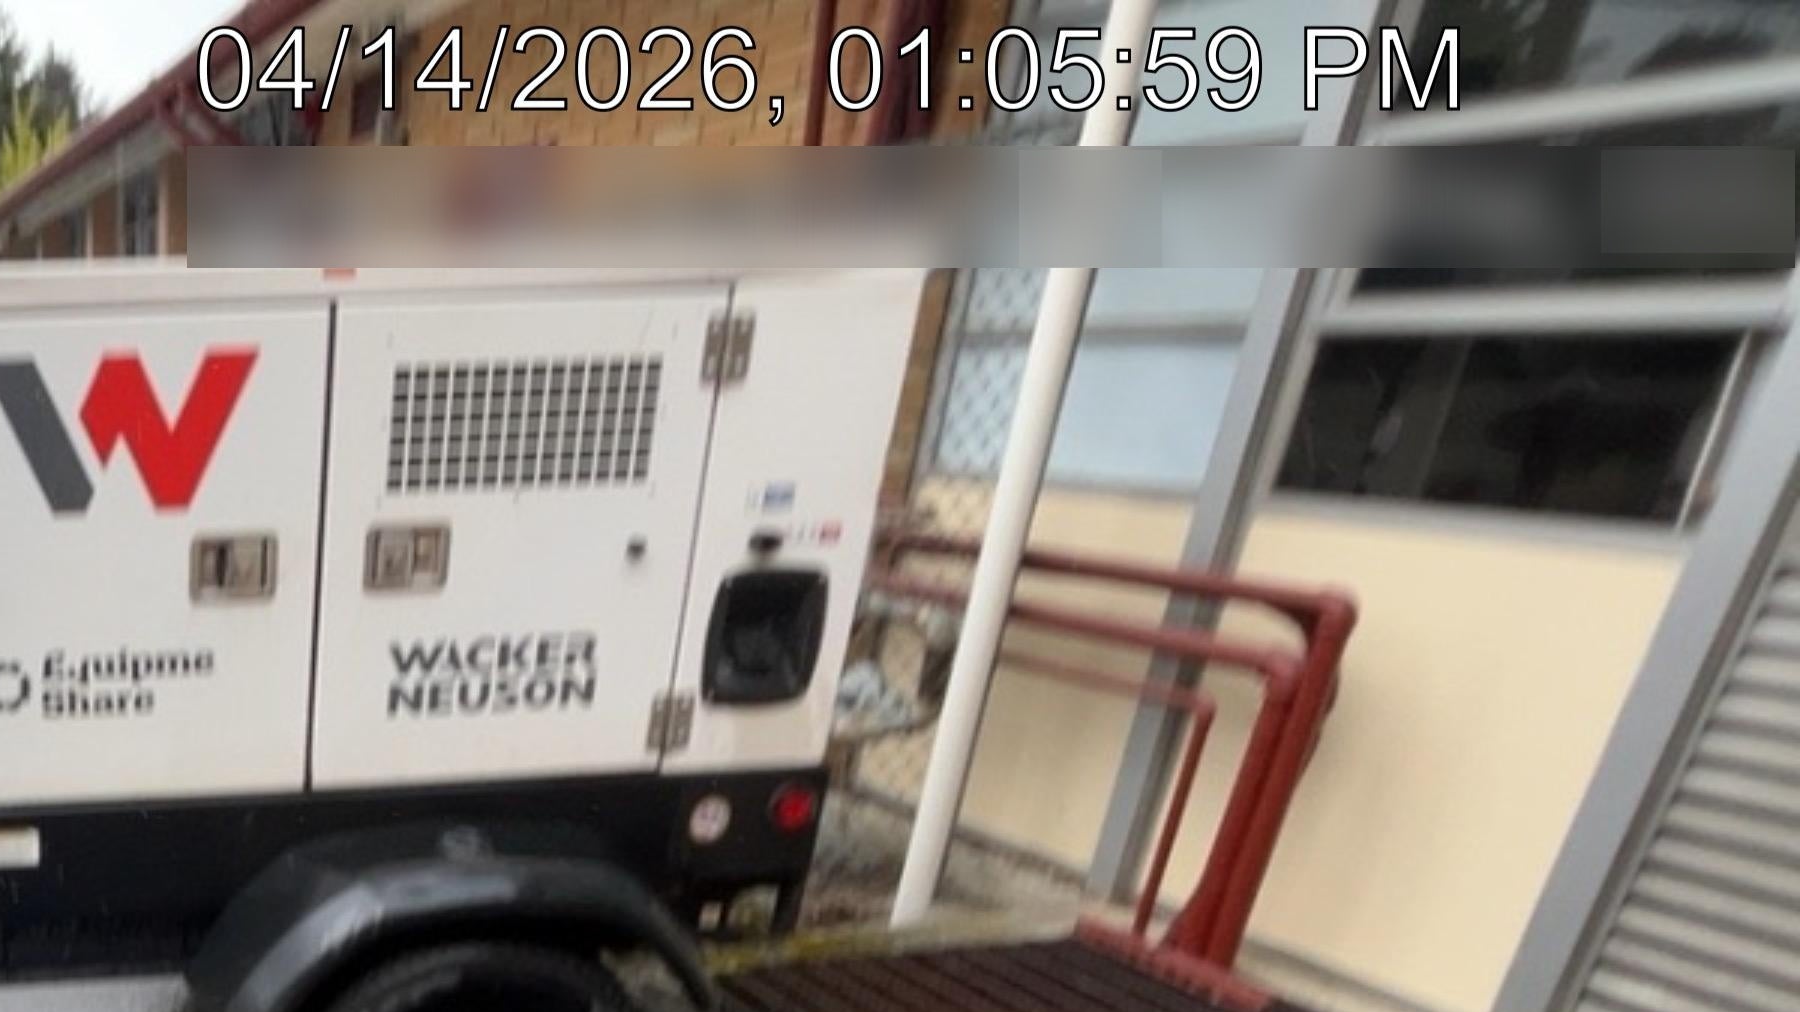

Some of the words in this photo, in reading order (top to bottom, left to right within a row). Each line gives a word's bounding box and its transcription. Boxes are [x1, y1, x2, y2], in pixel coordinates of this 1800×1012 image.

[388, 632, 597, 672] WACKER
[42, 688, 154, 719] Share
[386, 676, 596, 719] NEUSON
